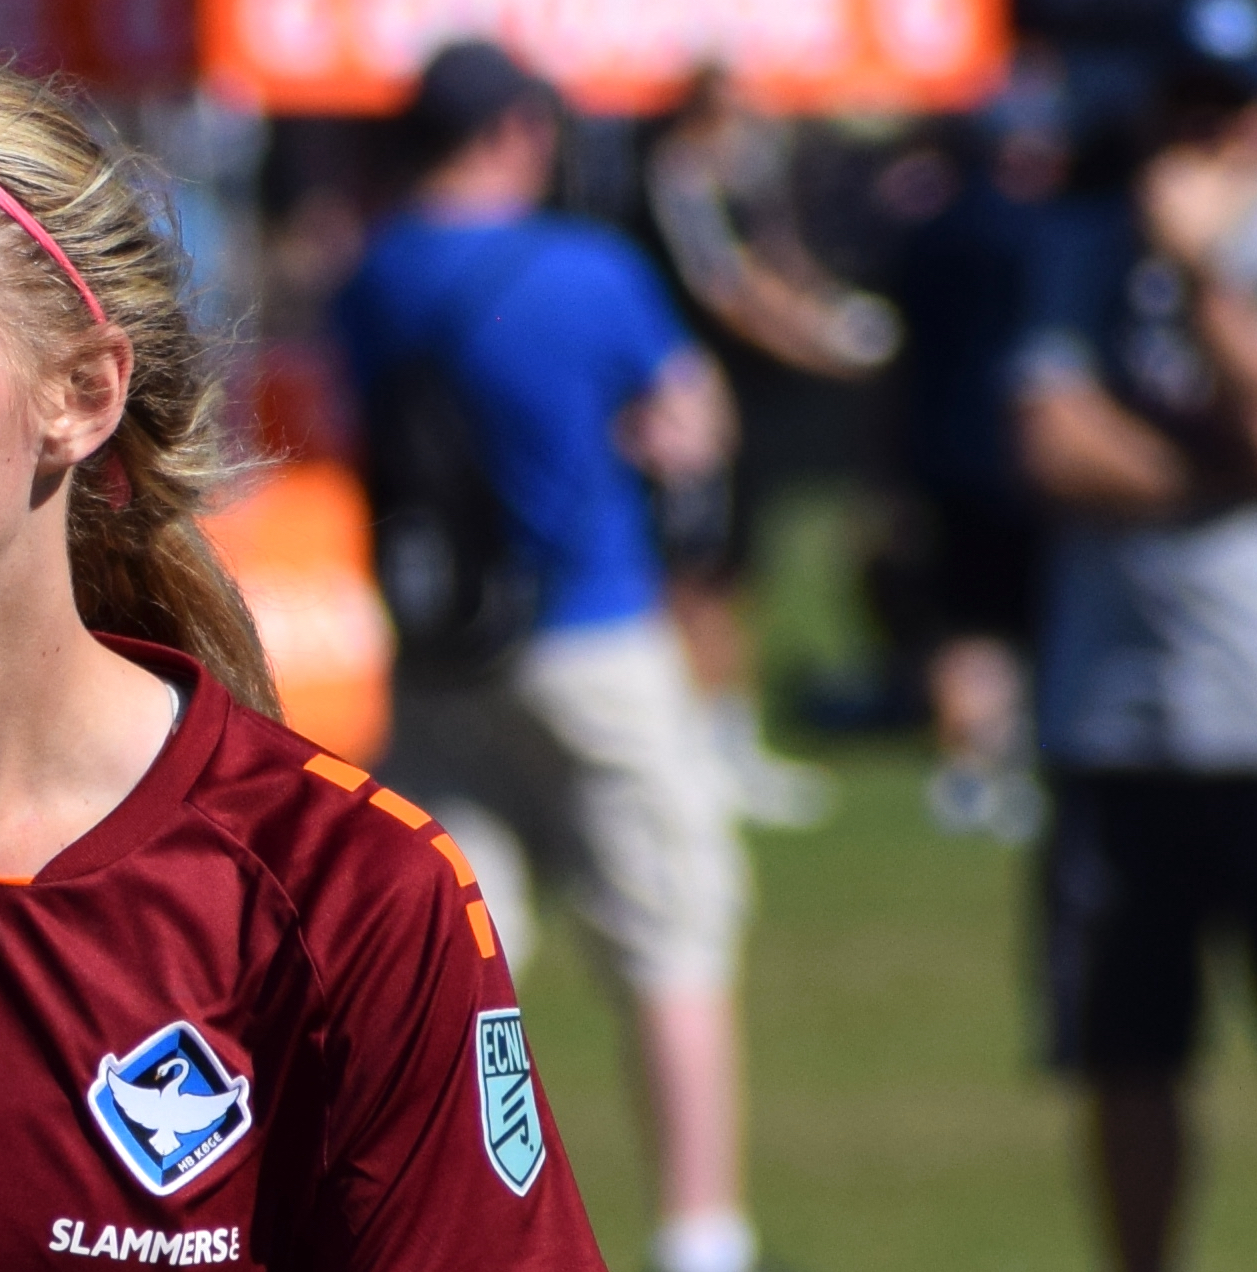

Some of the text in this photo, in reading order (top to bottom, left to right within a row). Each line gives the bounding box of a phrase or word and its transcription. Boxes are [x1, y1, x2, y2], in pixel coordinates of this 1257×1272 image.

[482, 1020, 530, 1074] ECNL
[177, 1155, 195, 1173] HB
[49, 1218, 228, 1266] SLAMMERS
